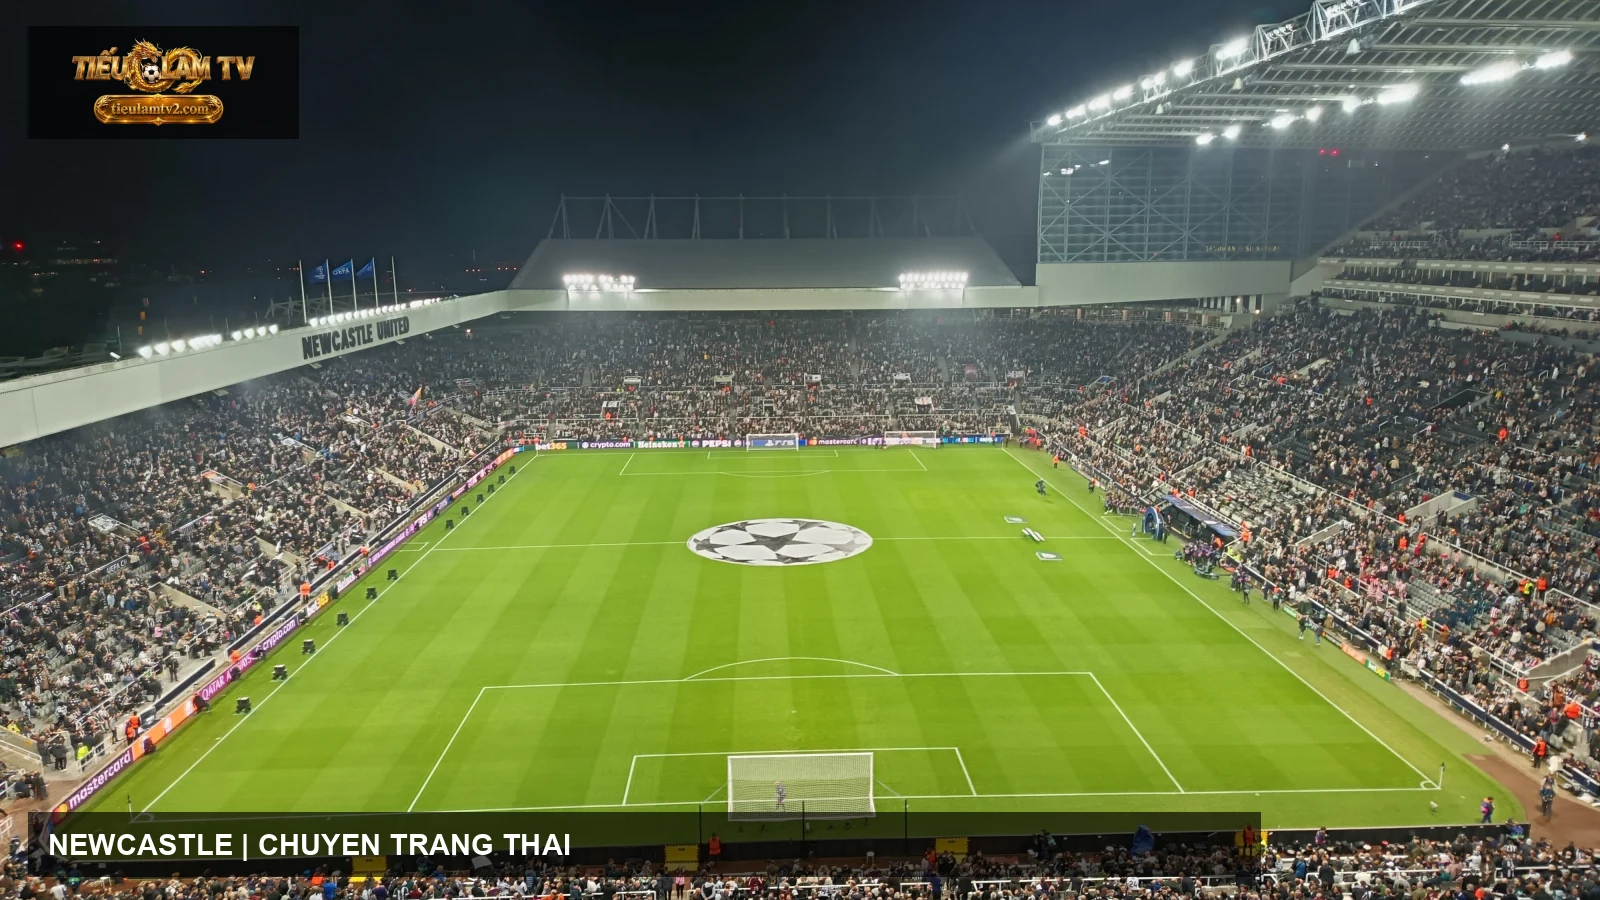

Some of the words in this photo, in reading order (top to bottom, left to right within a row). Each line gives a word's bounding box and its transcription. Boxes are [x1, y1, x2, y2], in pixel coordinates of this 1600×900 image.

[301, 323, 374, 360] NEWCASTLE
[376, 316, 410, 341] UNITED
[535, 442, 567, 450] bet365
[590, 441, 631, 449] crypto.com
[638, 440, 677, 448] Heineken
[106, 562, 120, 573] UEFA
[262, 619, 296, 650] crypto.com
[201, 675, 225, 701] QATAR
[69, 750, 131, 809] mastercard
[1129, 880, 1137, 888] 24
